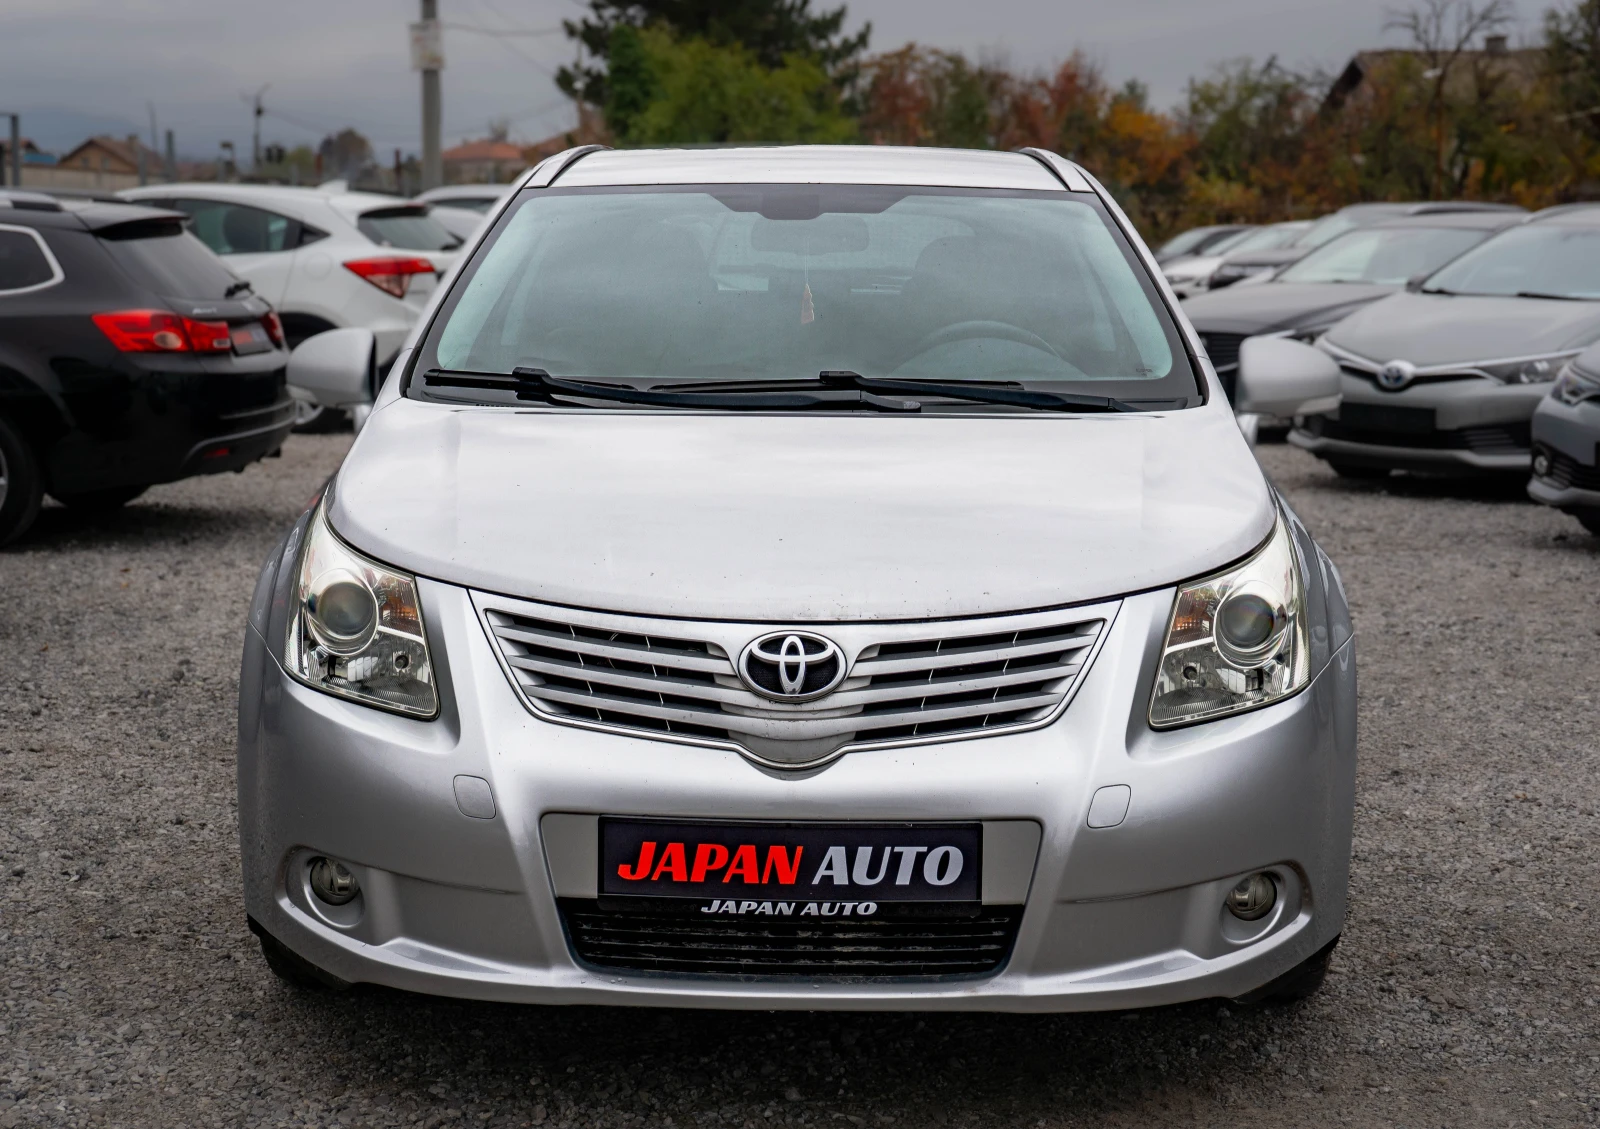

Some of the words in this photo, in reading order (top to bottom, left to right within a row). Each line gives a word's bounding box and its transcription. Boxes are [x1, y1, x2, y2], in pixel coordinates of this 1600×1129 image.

[617, 841, 804, 885] JAPAN
[811, 845, 964, 886] AUTO
[701, 900, 796, 916] JAPAN
[799, 901, 878, 916] AUTO
